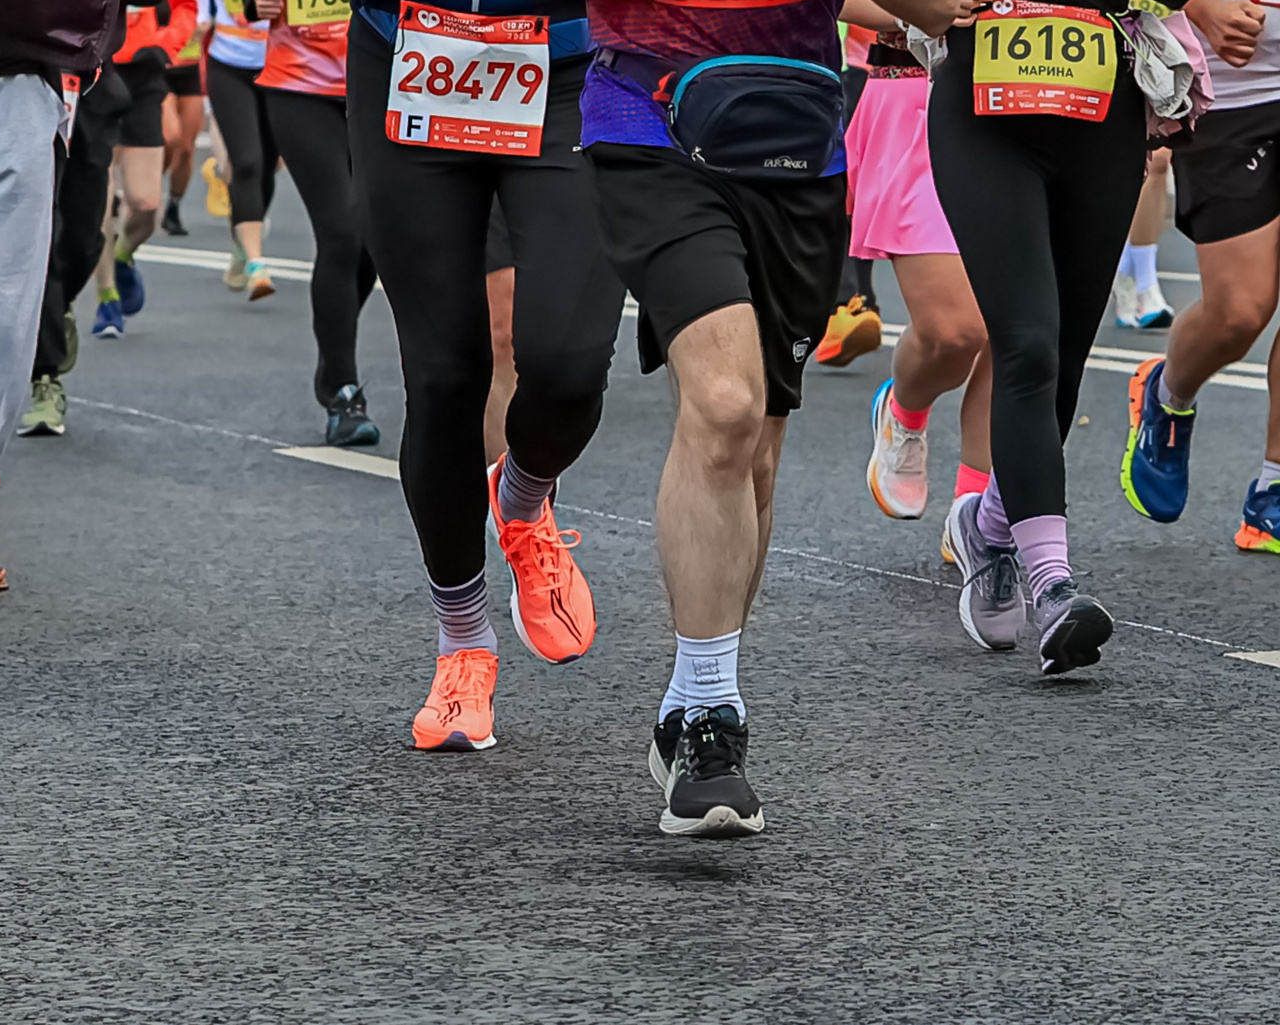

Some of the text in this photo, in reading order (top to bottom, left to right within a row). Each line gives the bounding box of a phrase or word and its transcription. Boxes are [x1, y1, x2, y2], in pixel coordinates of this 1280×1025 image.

[1017, 7, 1053, 16] МАРАФОН
[984, 24, 1106, 66] 16181
[398, 51, 544, 105] 28479
[1018, 65, 1074, 78] МАРИНА
[988, 87, 1004, 111] E
[406, 115, 423, 138] F
